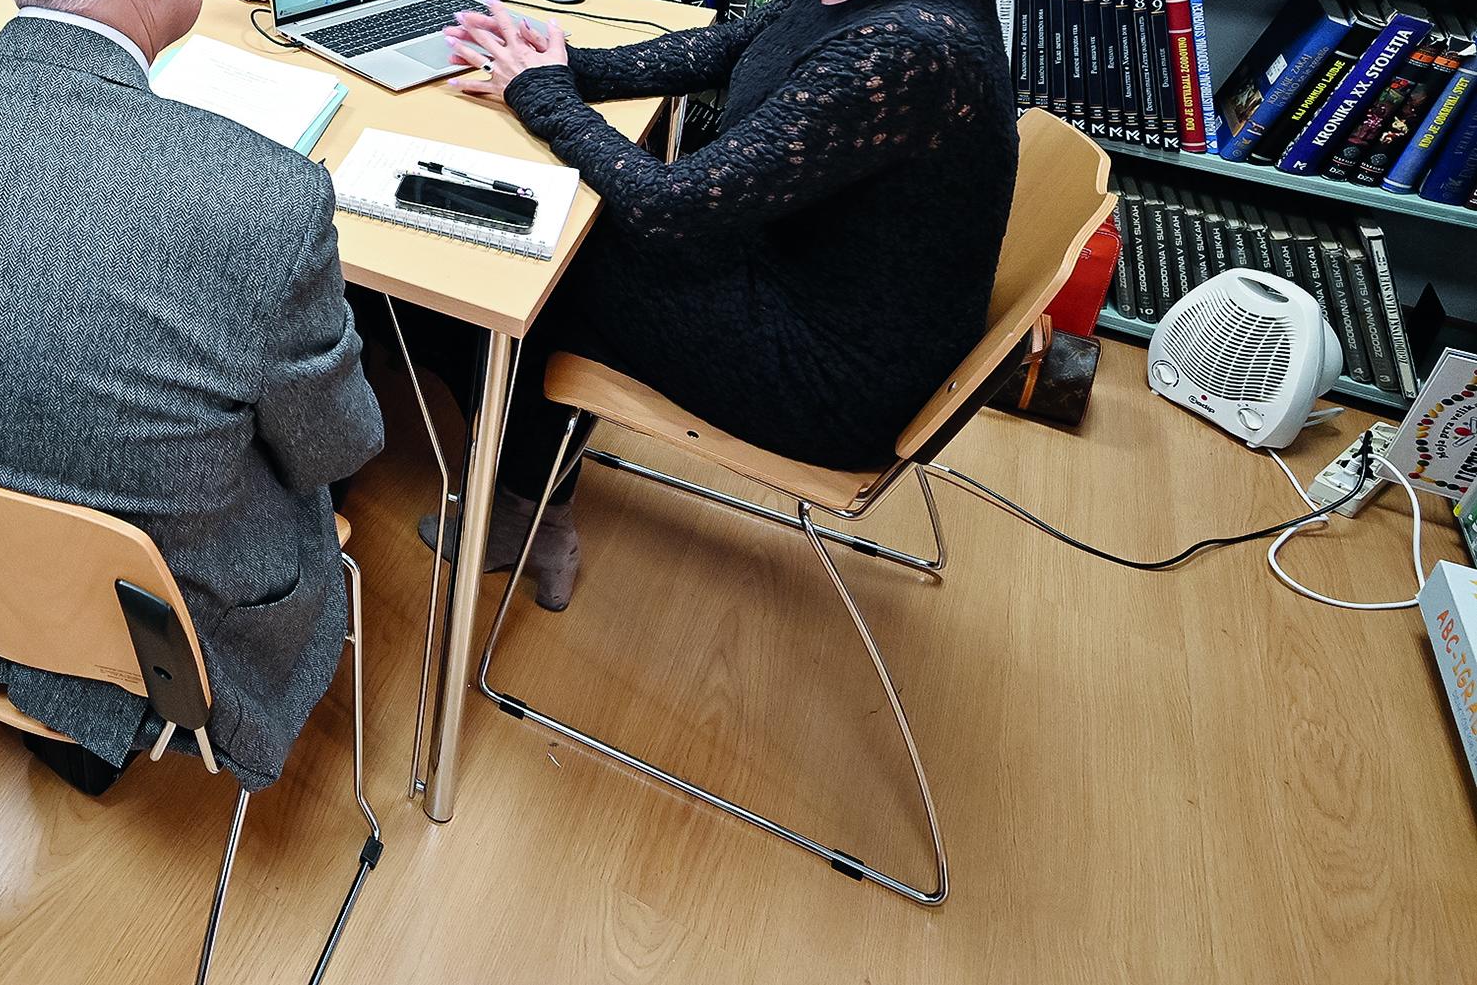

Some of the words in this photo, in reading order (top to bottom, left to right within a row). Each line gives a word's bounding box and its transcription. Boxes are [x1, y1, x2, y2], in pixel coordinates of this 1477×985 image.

[1152, 0, 1163, 12] 9
[1312, 96, 1356, 147] KRONIKA
[1353, 78, 1374, 99] XX.
[1371, 29, 1413, 80] STOLETJA
[1291, 107, 1306, 122] KAJ
[1419, 131, 1435, 148] KDO
[1429, 122, 1439, 134] JE
[1434, 94, 1459, 125] ODKRIVAL
[1454, 77, 1471, 97] SVET
[1135, 245, 1147, 292] ZGODOVINA
[1158, 242, 1164, 250] V
[1158, 250, 1170, 298] ZGODOVINA
[1337, 290, 1344, 299] V
[1339, 298, 1356, 350] ZGODOVINA
[1363, 298, 1369, 306] V
[1365, 306, 1383, 358] ZGODOVINA
